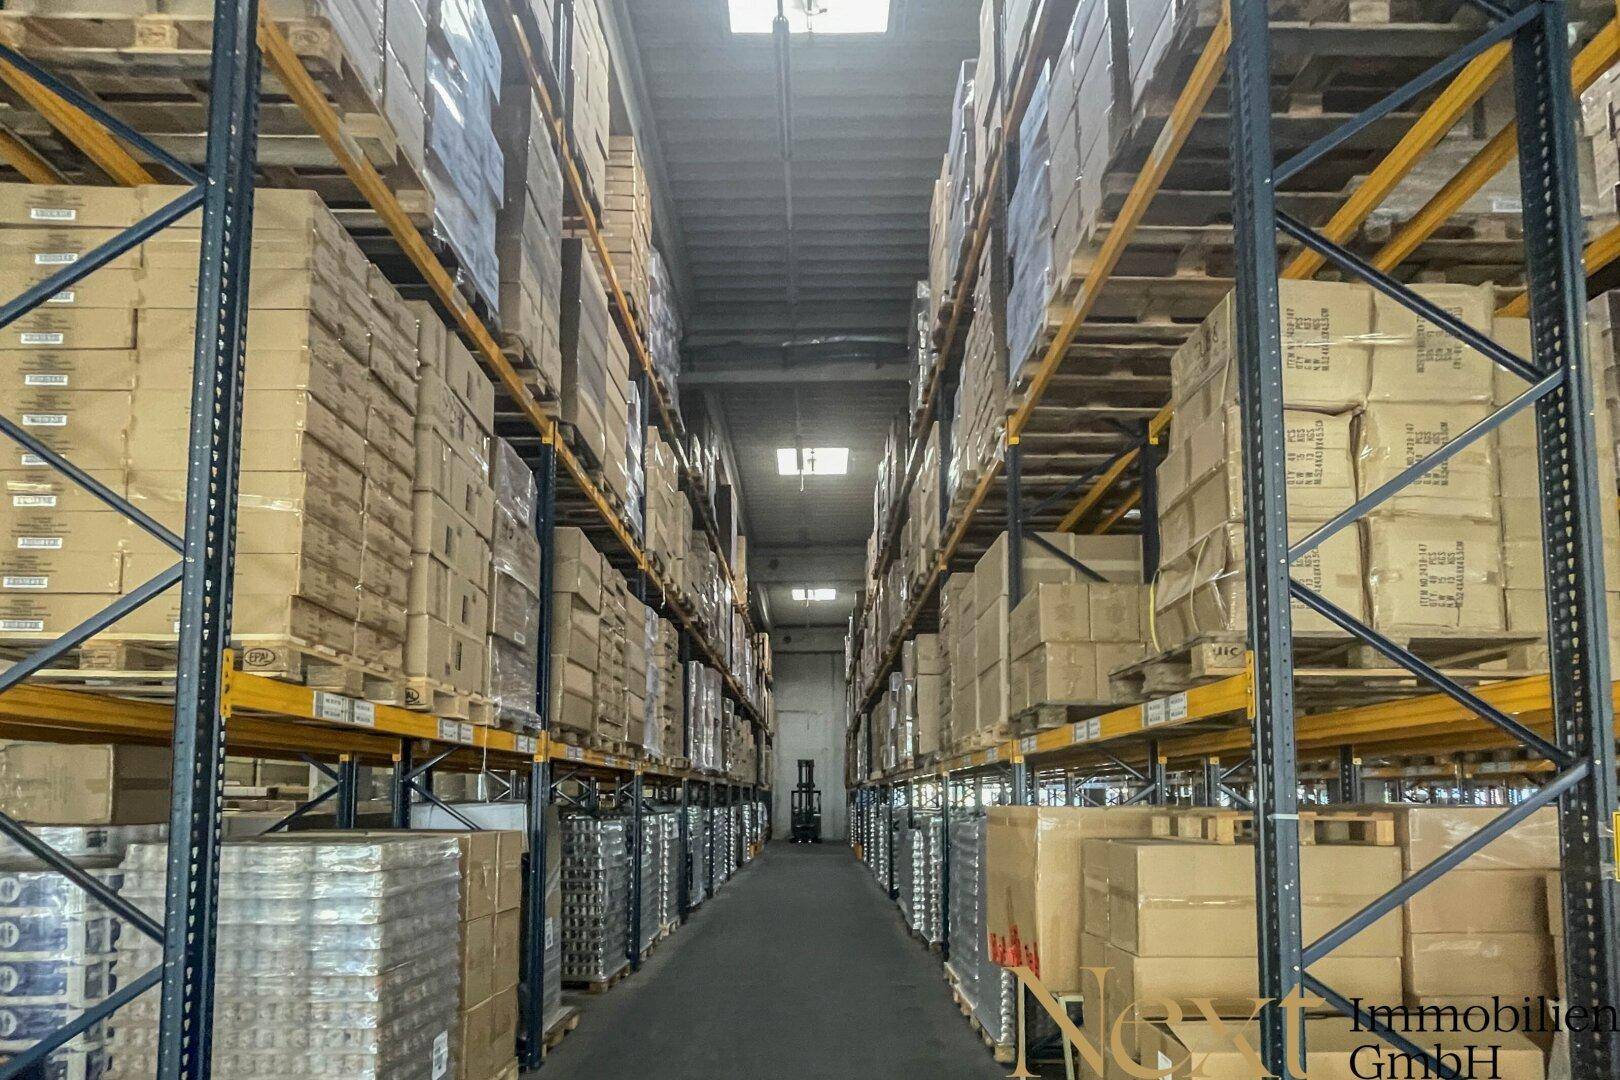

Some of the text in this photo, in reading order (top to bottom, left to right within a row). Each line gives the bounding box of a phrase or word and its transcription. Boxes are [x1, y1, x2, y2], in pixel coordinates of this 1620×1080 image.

[1287, 429, 1295, 442] PCS
[1287, 471, 1295, 485] QTY
[1428, 552, 1436, 565] PCS
[1438, 551, 1446, 566] KGS
[1446, 552, 1455, 565] KGS
[1418, 590, 1429, 607] ITEM
[1429, 593, 1437, 608] QTY
[249, 652, 270, 663] EPAL
